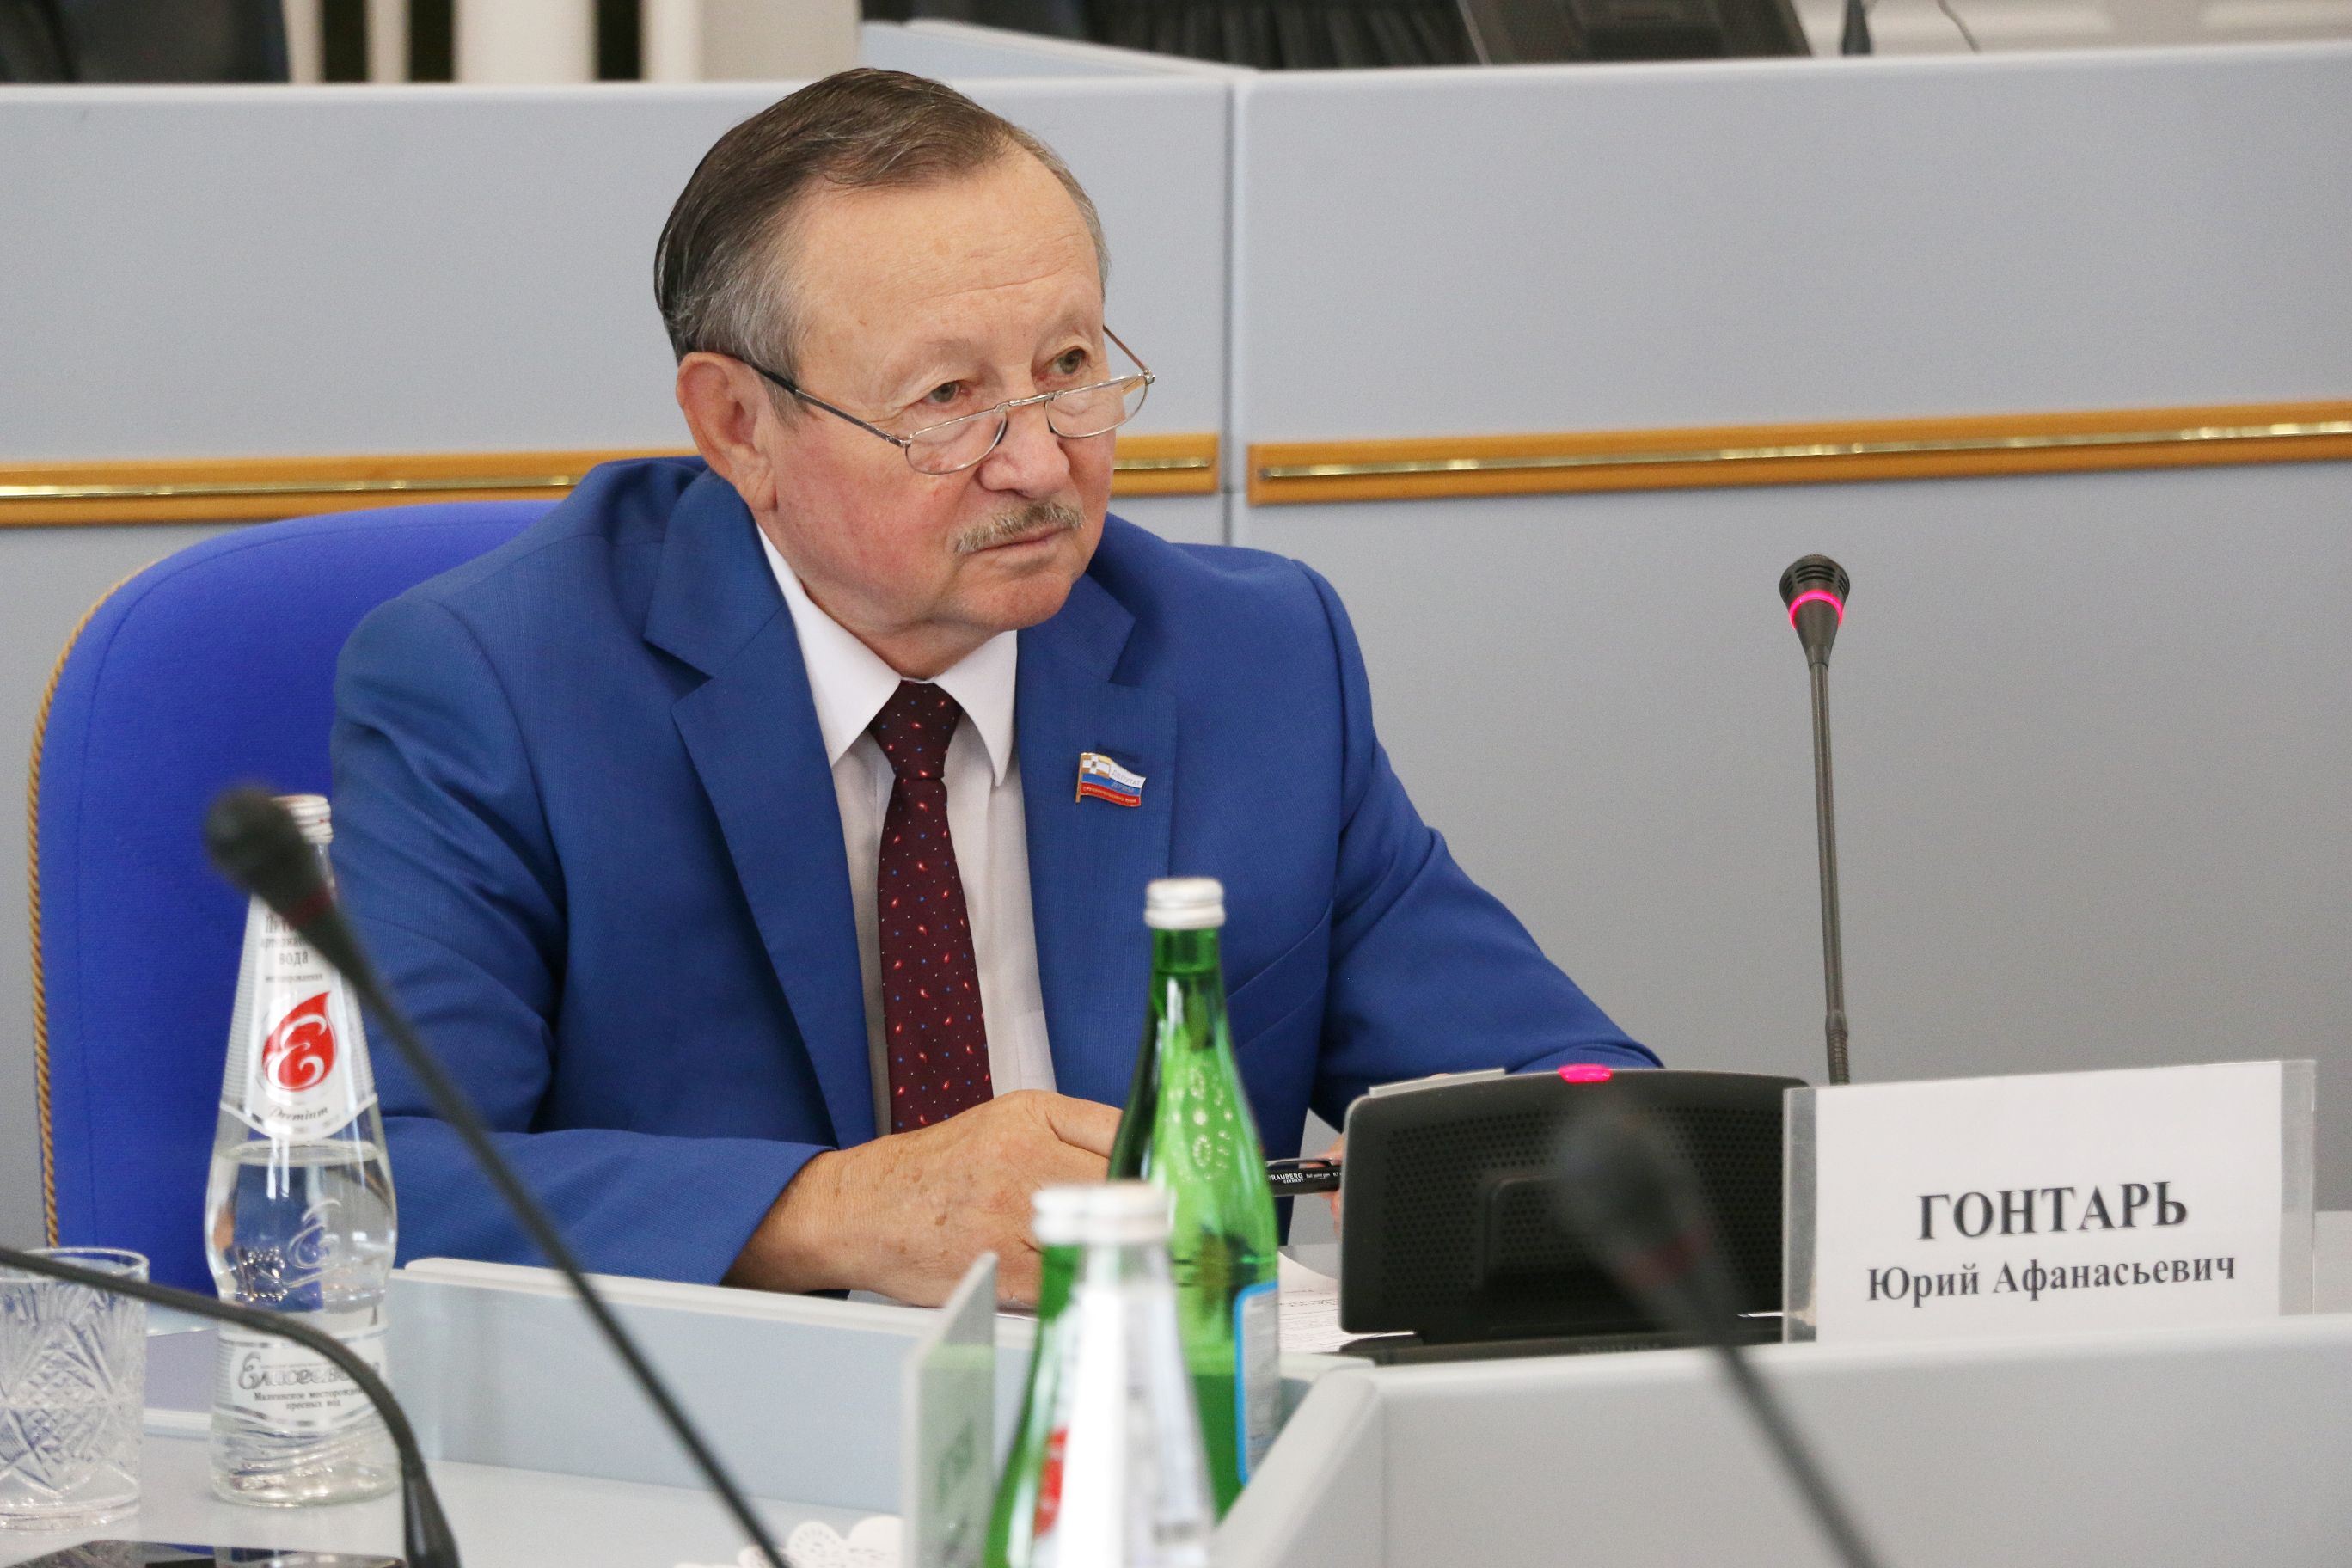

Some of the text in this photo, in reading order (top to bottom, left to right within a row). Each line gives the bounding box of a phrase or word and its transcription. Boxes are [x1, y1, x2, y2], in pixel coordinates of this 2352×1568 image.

[1917, 1181, 2187, 1240] ГОНТАРЬ
[1866, 1257, 2235, 1308] Юрий Афанасьевич
